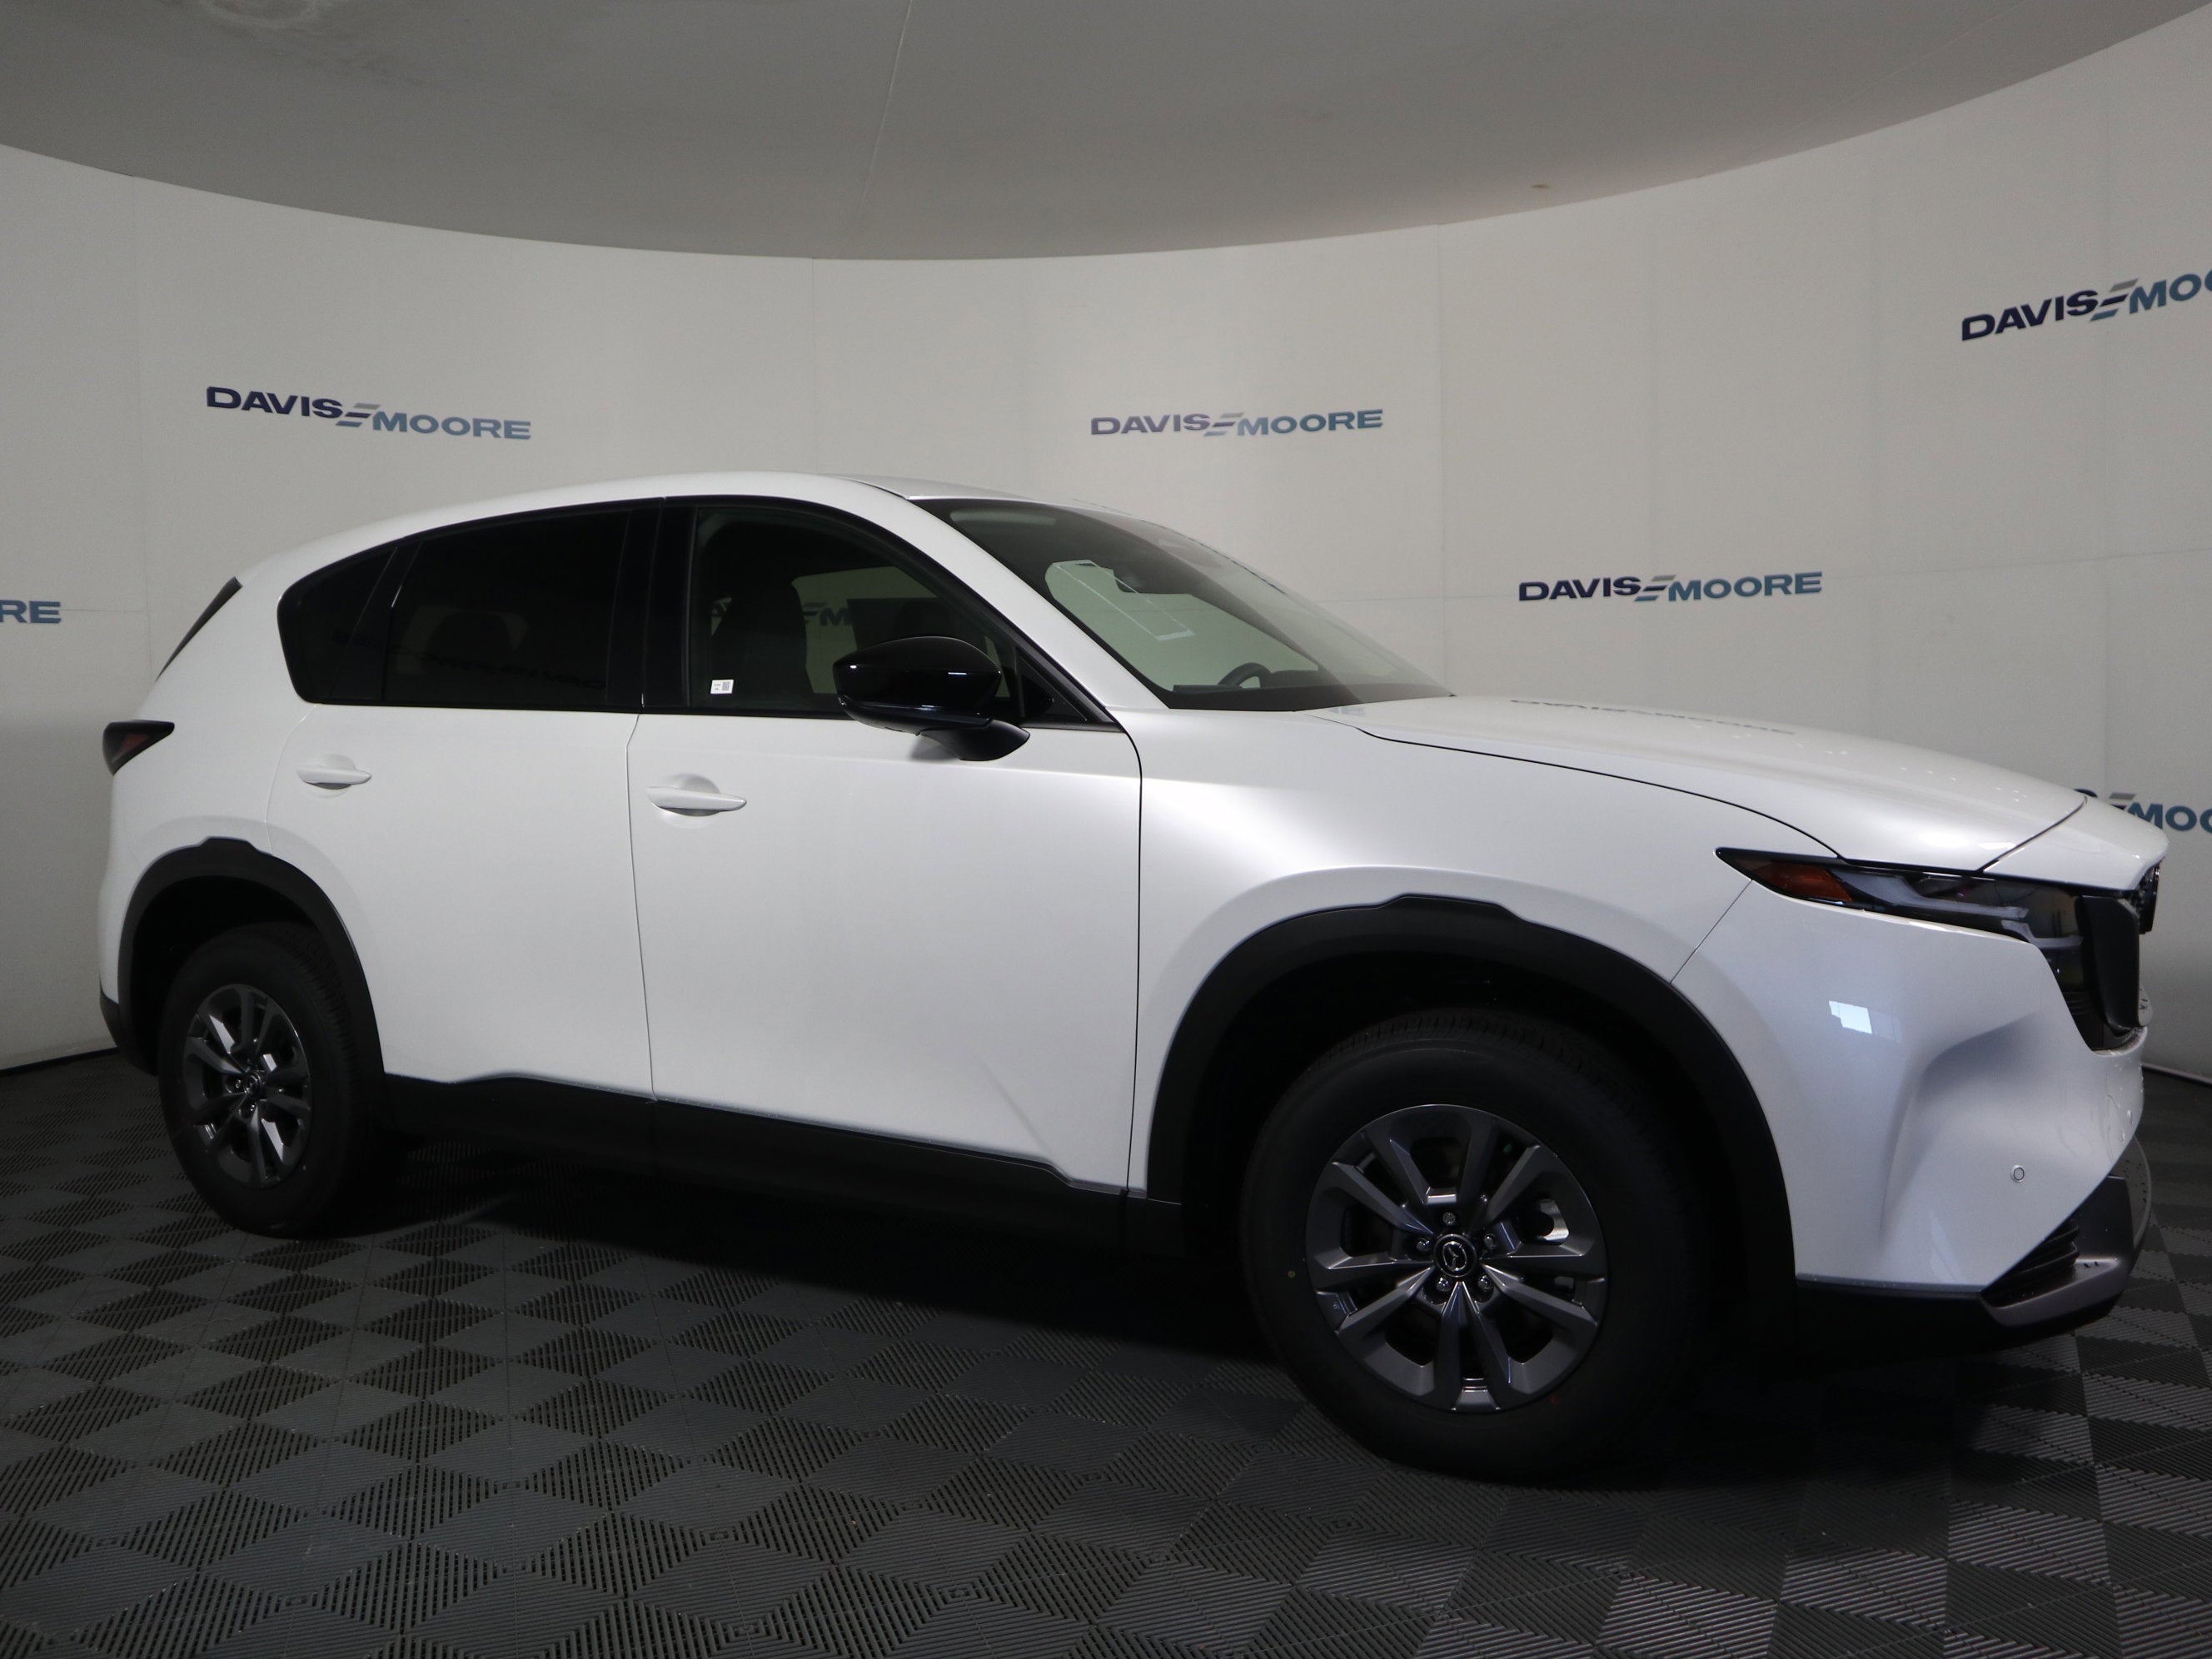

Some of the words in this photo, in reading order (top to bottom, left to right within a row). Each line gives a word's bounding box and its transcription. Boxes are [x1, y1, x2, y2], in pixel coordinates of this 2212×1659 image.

[1961, 289, 2100, 341] DAVIS
[2129, 268, 2212, 315] MO
[206, 386, 344, 419] DAVIS
[372, 411, 531, 441] MOORE
[1090, 413, 1211, 435] DAVIS
[1237, 409, 1384, 436] MOORE
[1518, 575, 1642, 601] DAVIS
[1668, 571, 1823, 602] MOORE
